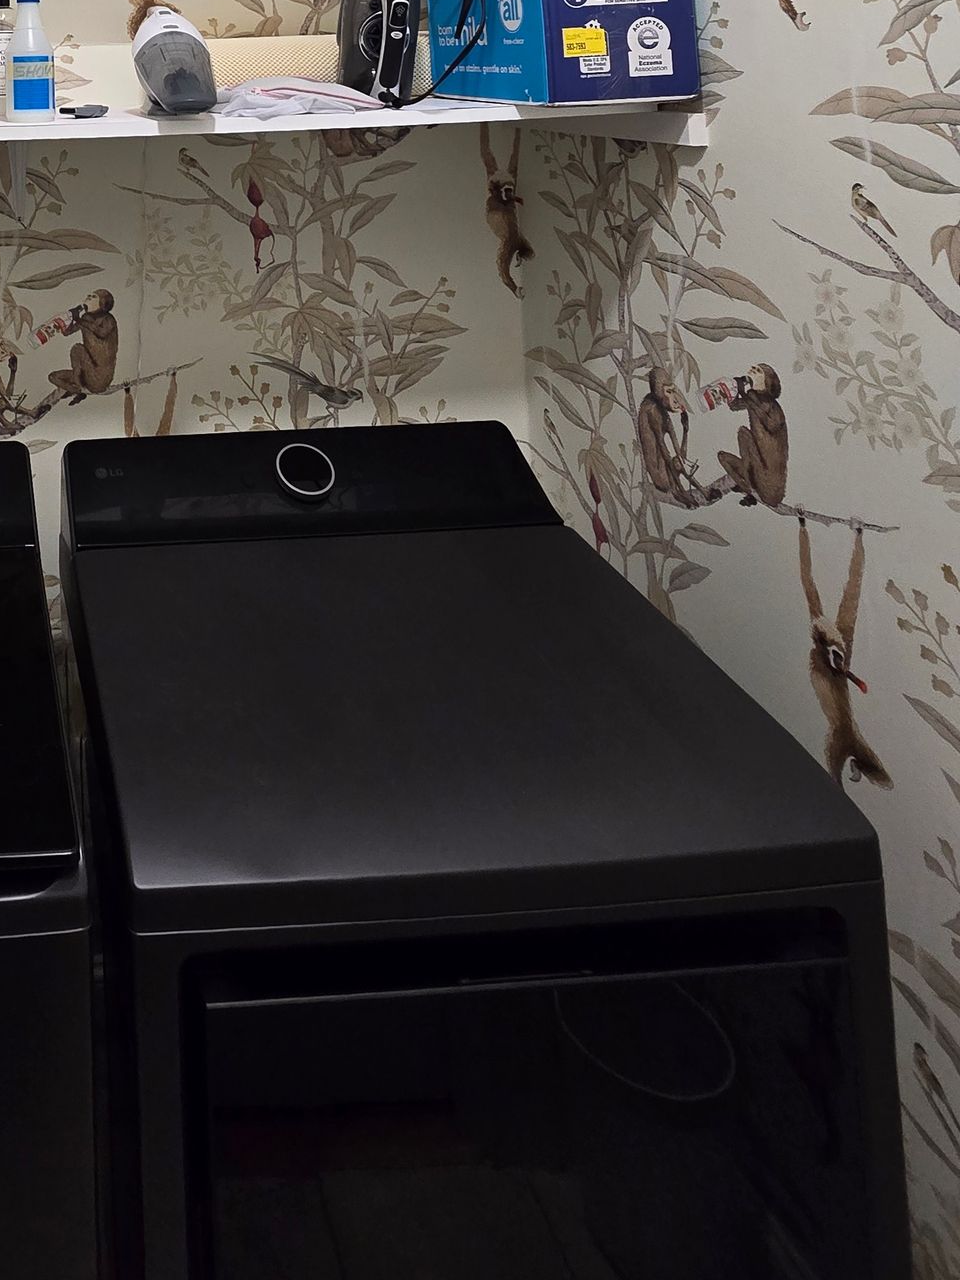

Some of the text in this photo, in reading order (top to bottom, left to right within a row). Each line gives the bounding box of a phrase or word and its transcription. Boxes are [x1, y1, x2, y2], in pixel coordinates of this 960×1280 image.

[632, 19, 664, 32] ACCEPTED
[634, 65, 668, 73] Association
[109, 468, 124, 477] LG
